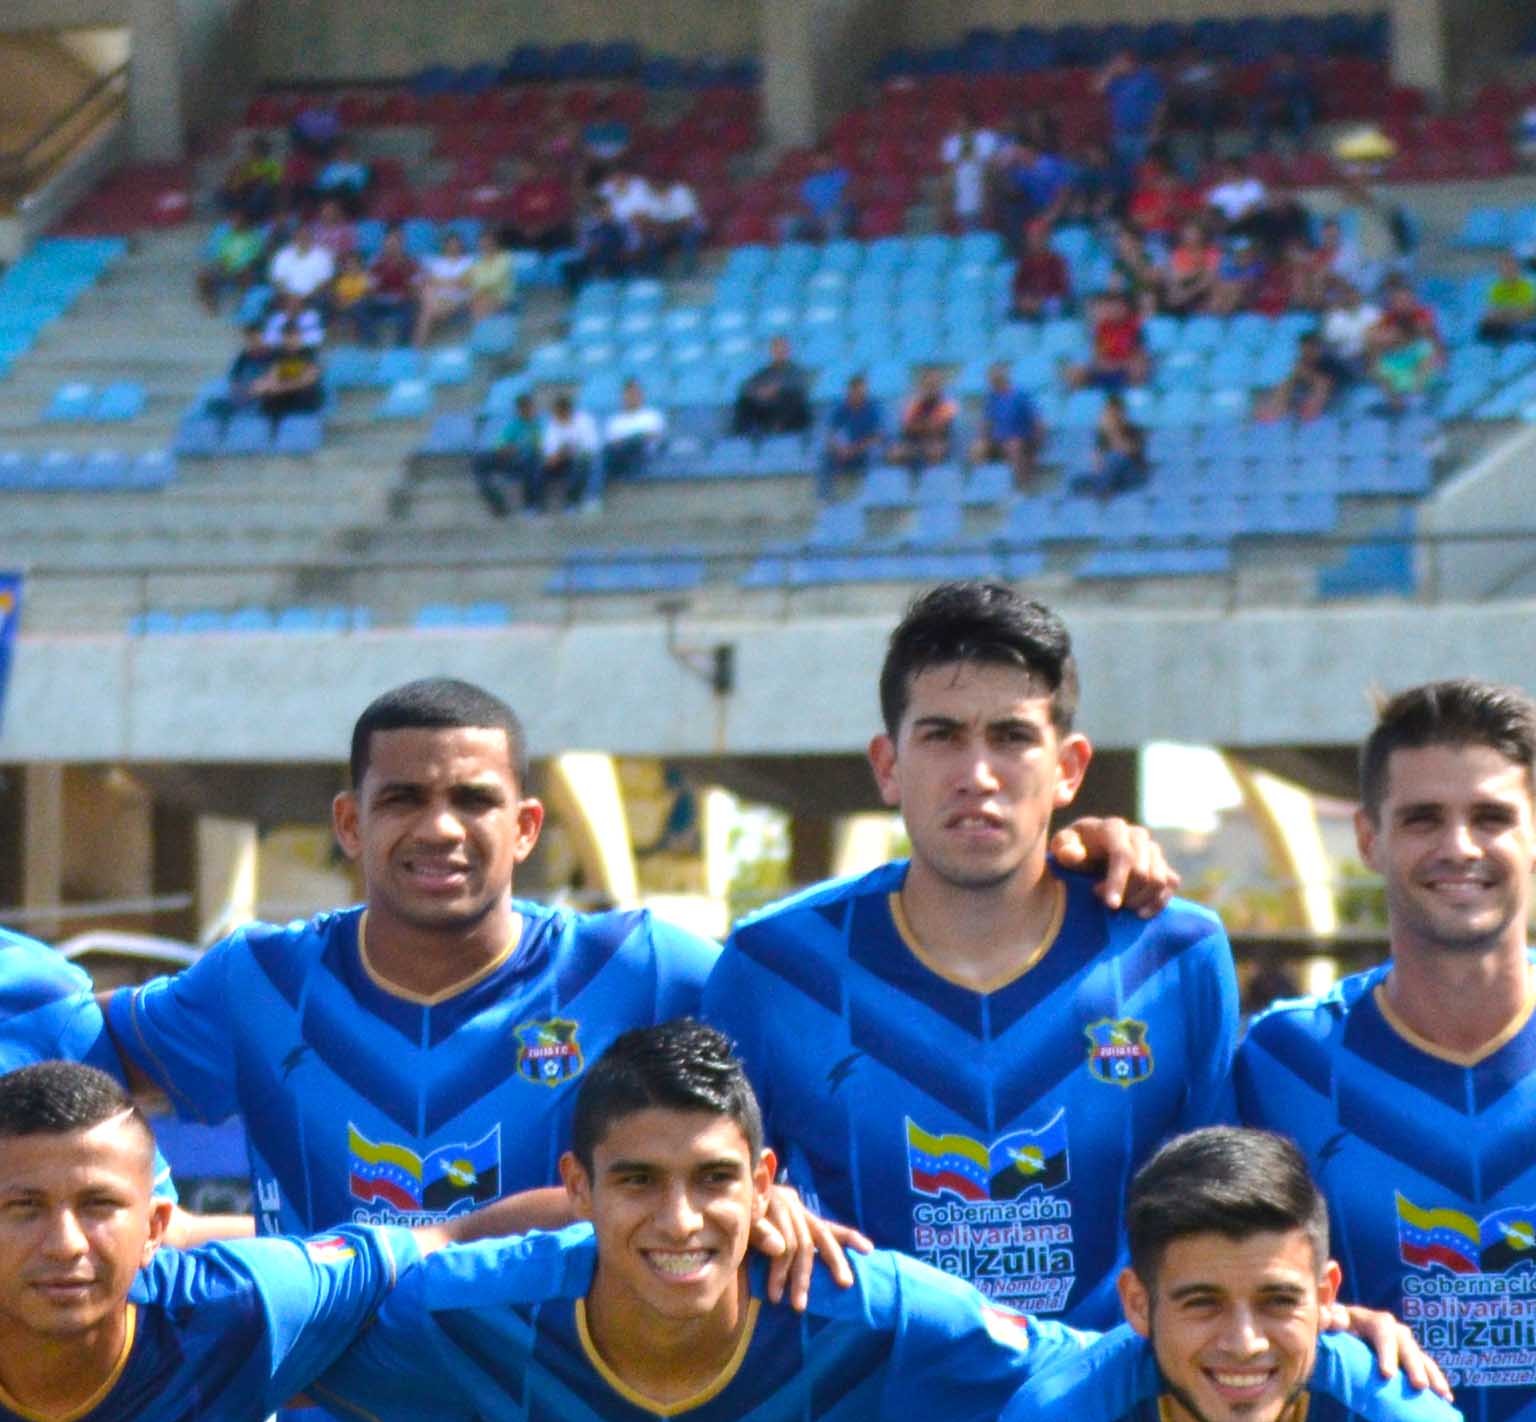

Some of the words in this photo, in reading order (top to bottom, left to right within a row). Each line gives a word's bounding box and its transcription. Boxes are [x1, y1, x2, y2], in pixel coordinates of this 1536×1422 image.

[912, 1197, 1072, 1226] Gobernación
[914, 1221, 1073, 1250] Bolivariana
[974, 1243, 1074, 1277] Zulia
